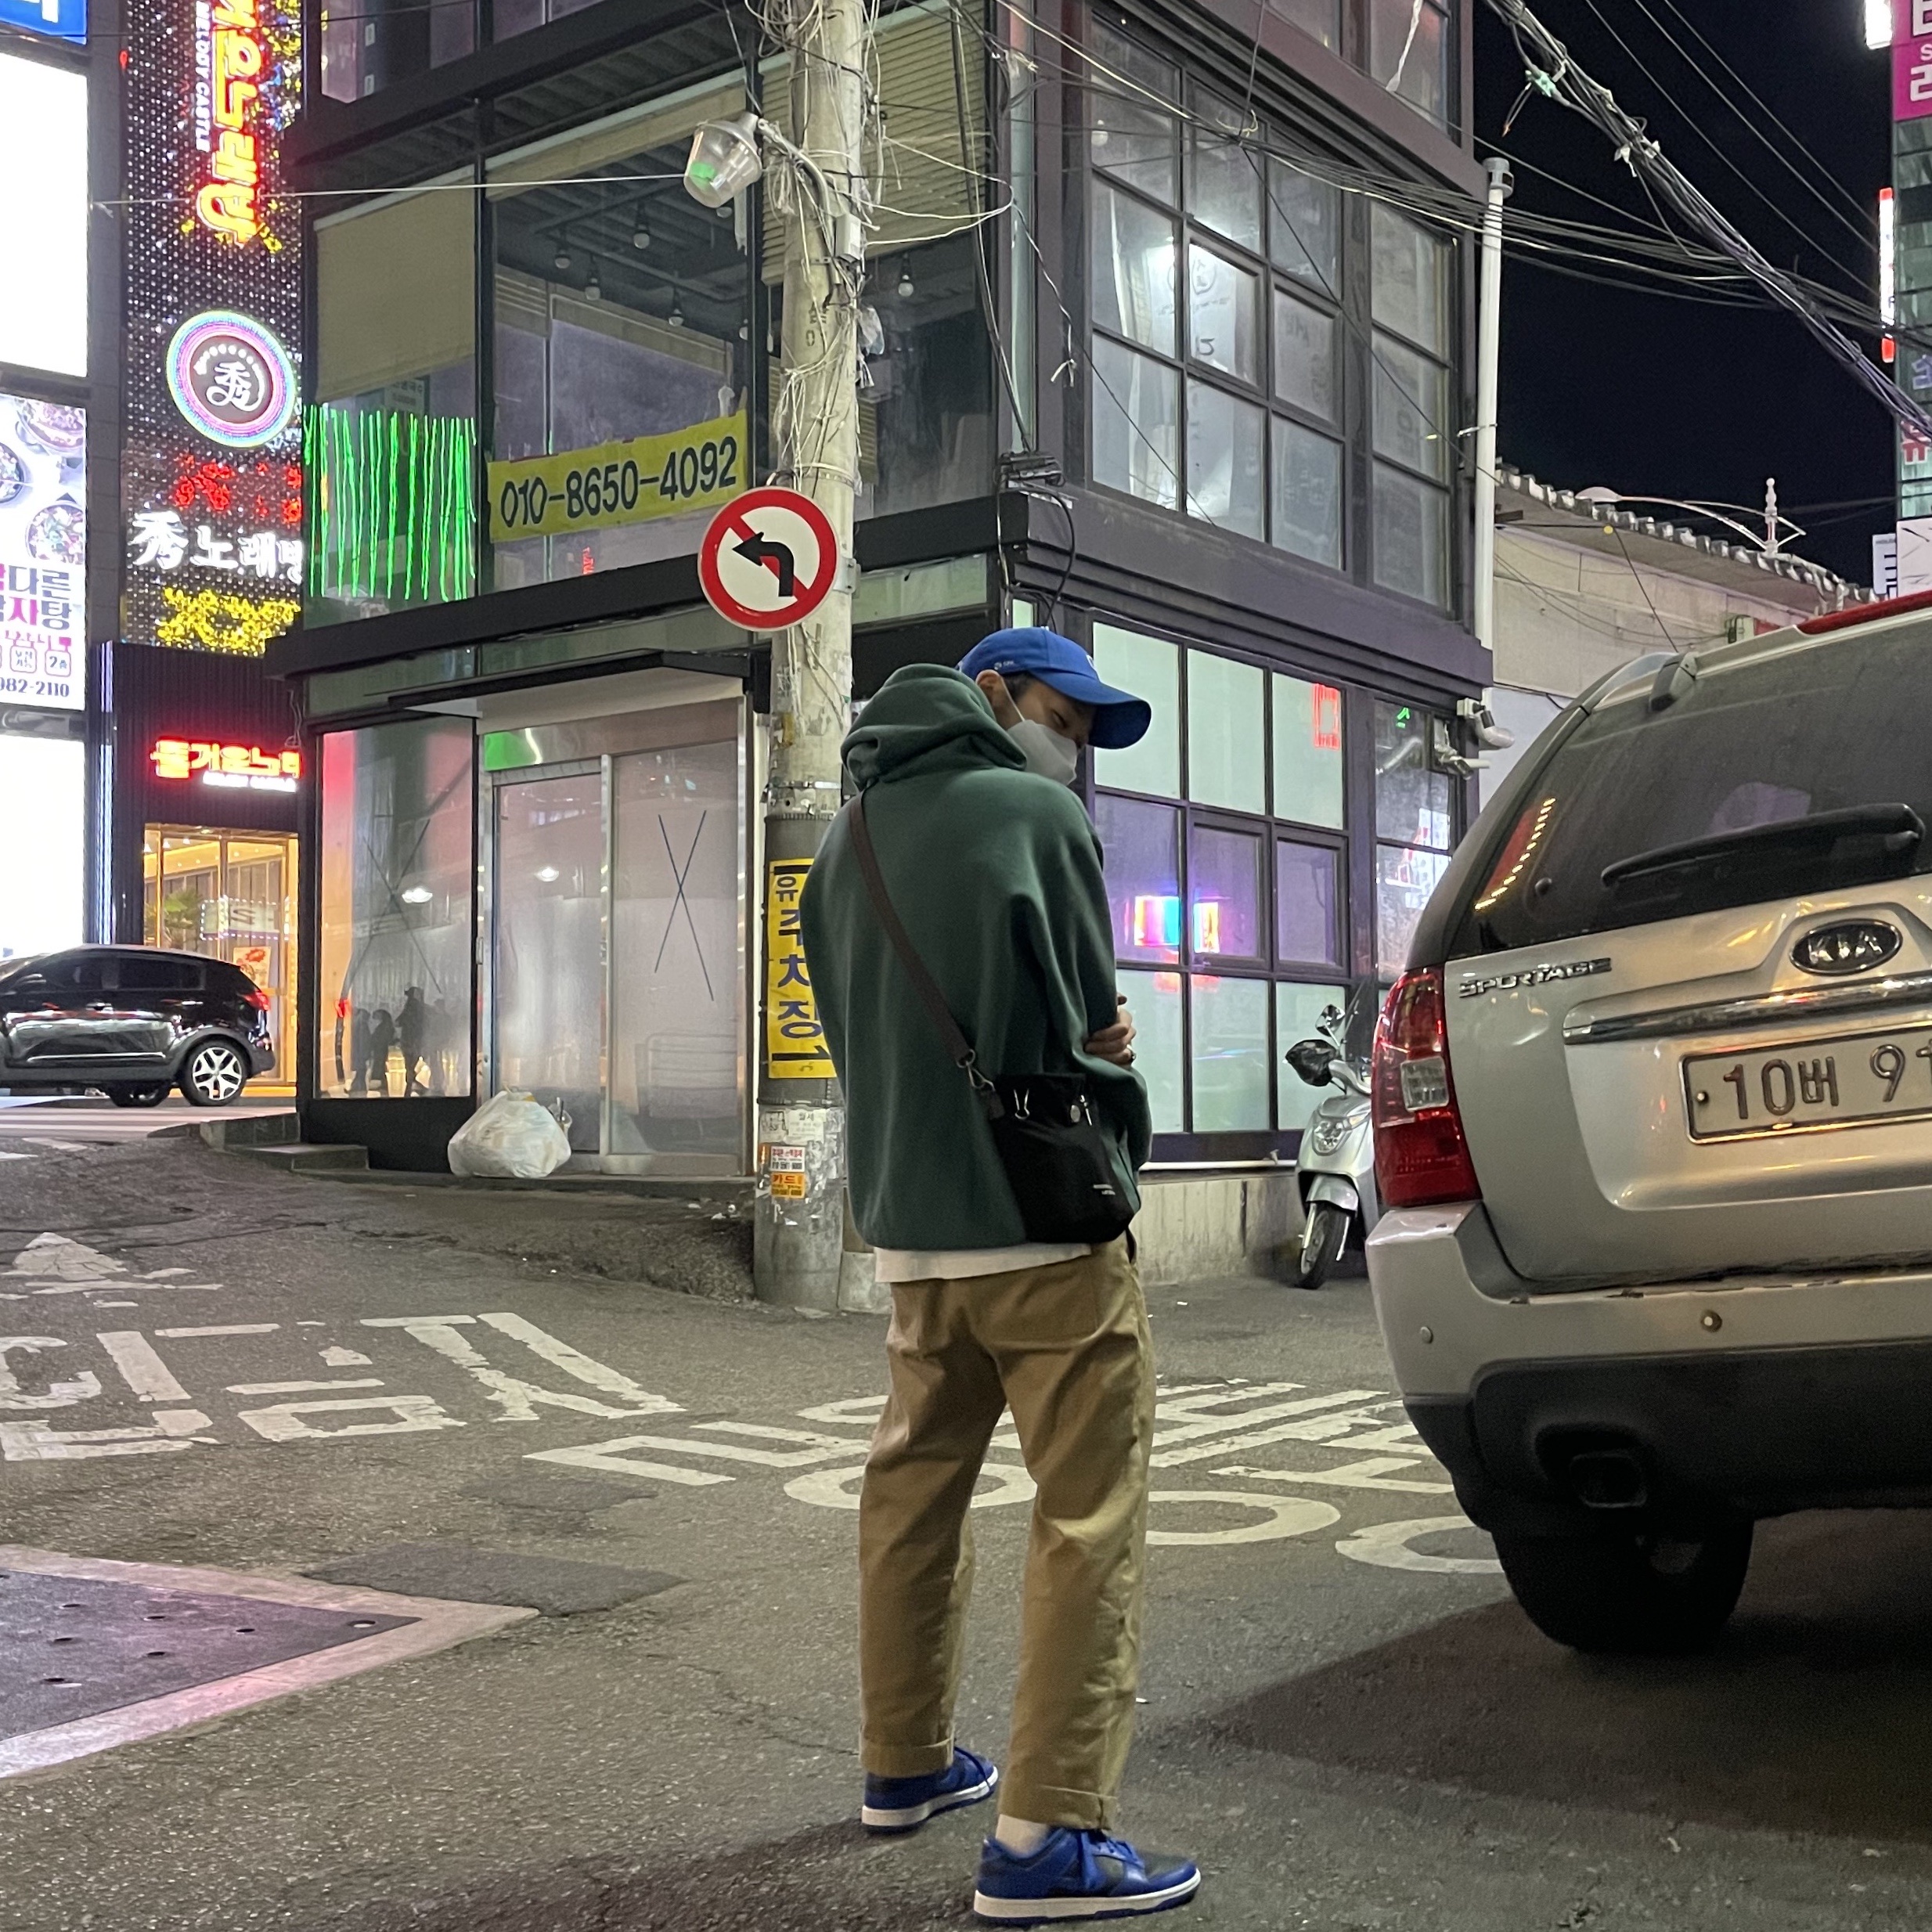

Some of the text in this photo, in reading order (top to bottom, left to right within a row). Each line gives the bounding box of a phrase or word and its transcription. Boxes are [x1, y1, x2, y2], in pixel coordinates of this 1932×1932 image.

[195, 1, 212, 153] MELODY CASTLE
[501, 436, 737, 528] 010-8650-4092
[0, 564, 71, 601] 다른
[0, 594, 71, 631] 자탕
[1808, 929, 1883, 964] KIA
[1459, 957, 1613, 998] SPORTAGE
[1723, 1056, 1840, 1120] 10버
